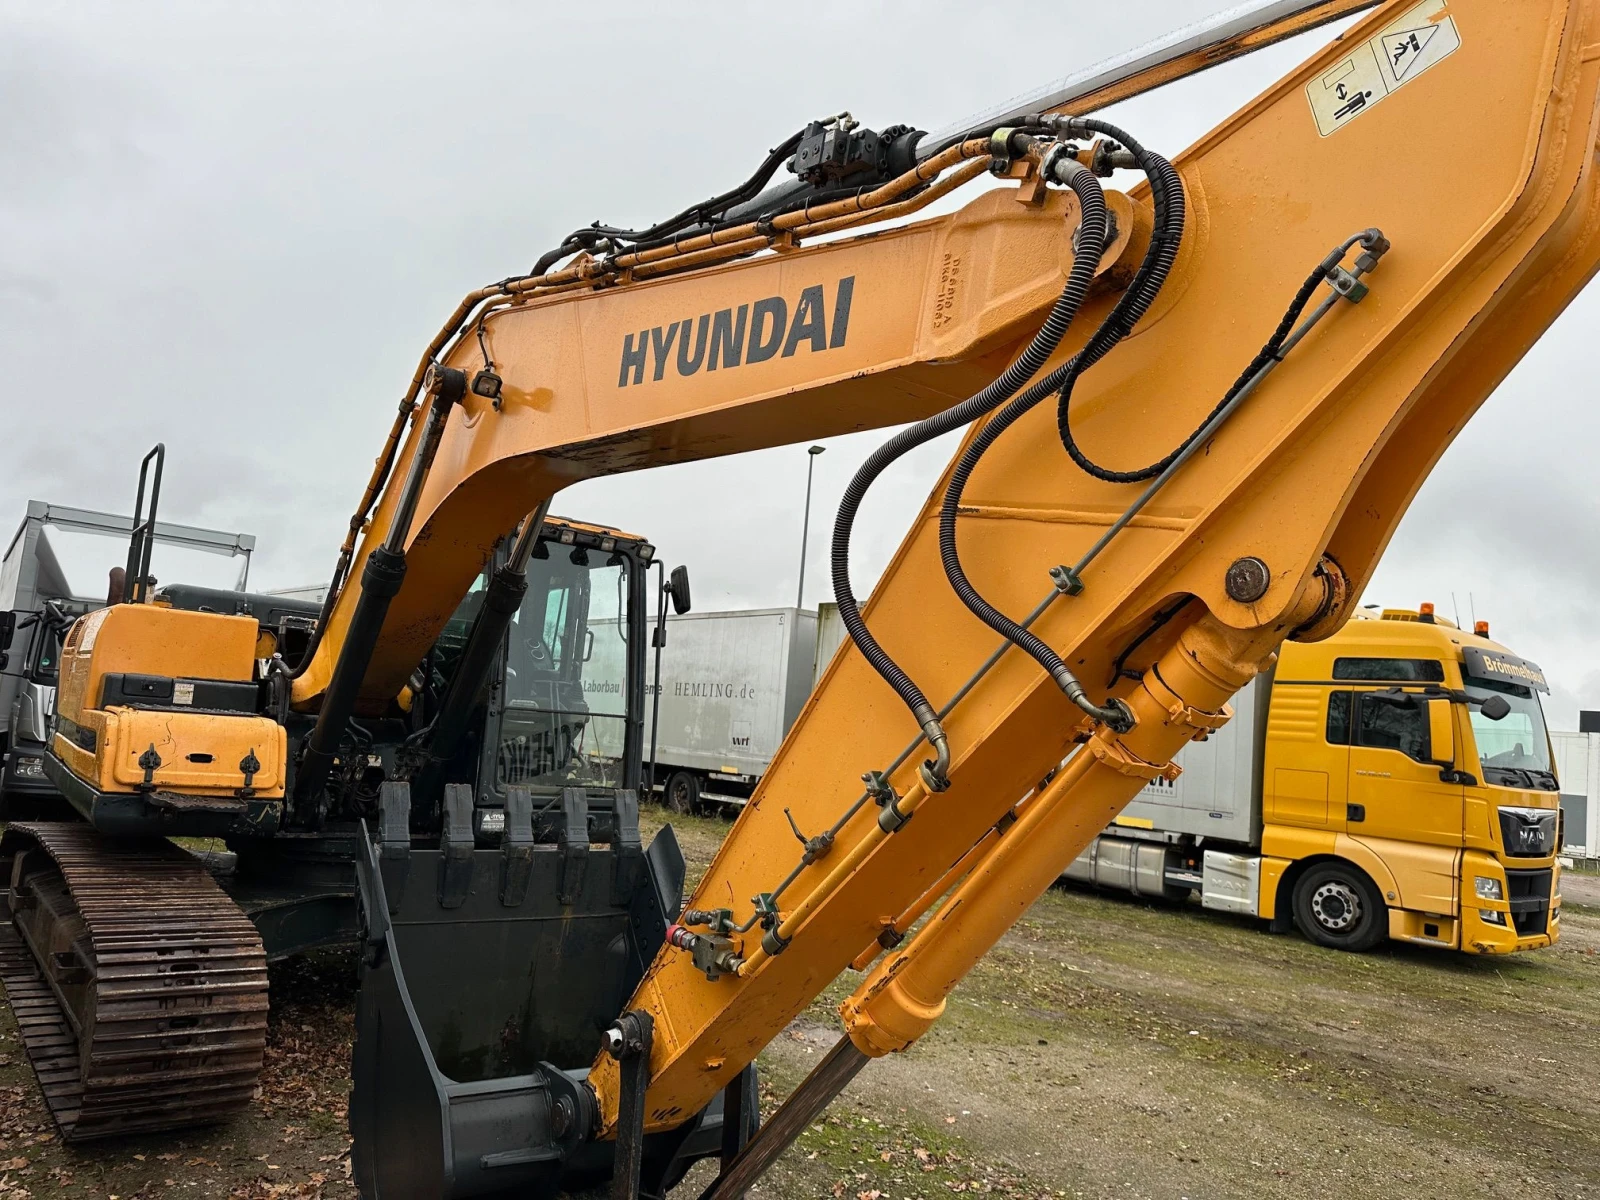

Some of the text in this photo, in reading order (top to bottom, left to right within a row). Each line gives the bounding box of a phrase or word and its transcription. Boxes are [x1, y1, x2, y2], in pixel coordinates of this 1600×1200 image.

[617, 275, 856, 388] HYUNDAI
[583, 680, 620, 693] Laborbau
[674, 682, 755, 699] HEMLING.de
[1520, 830, 1545, 845] MAN
